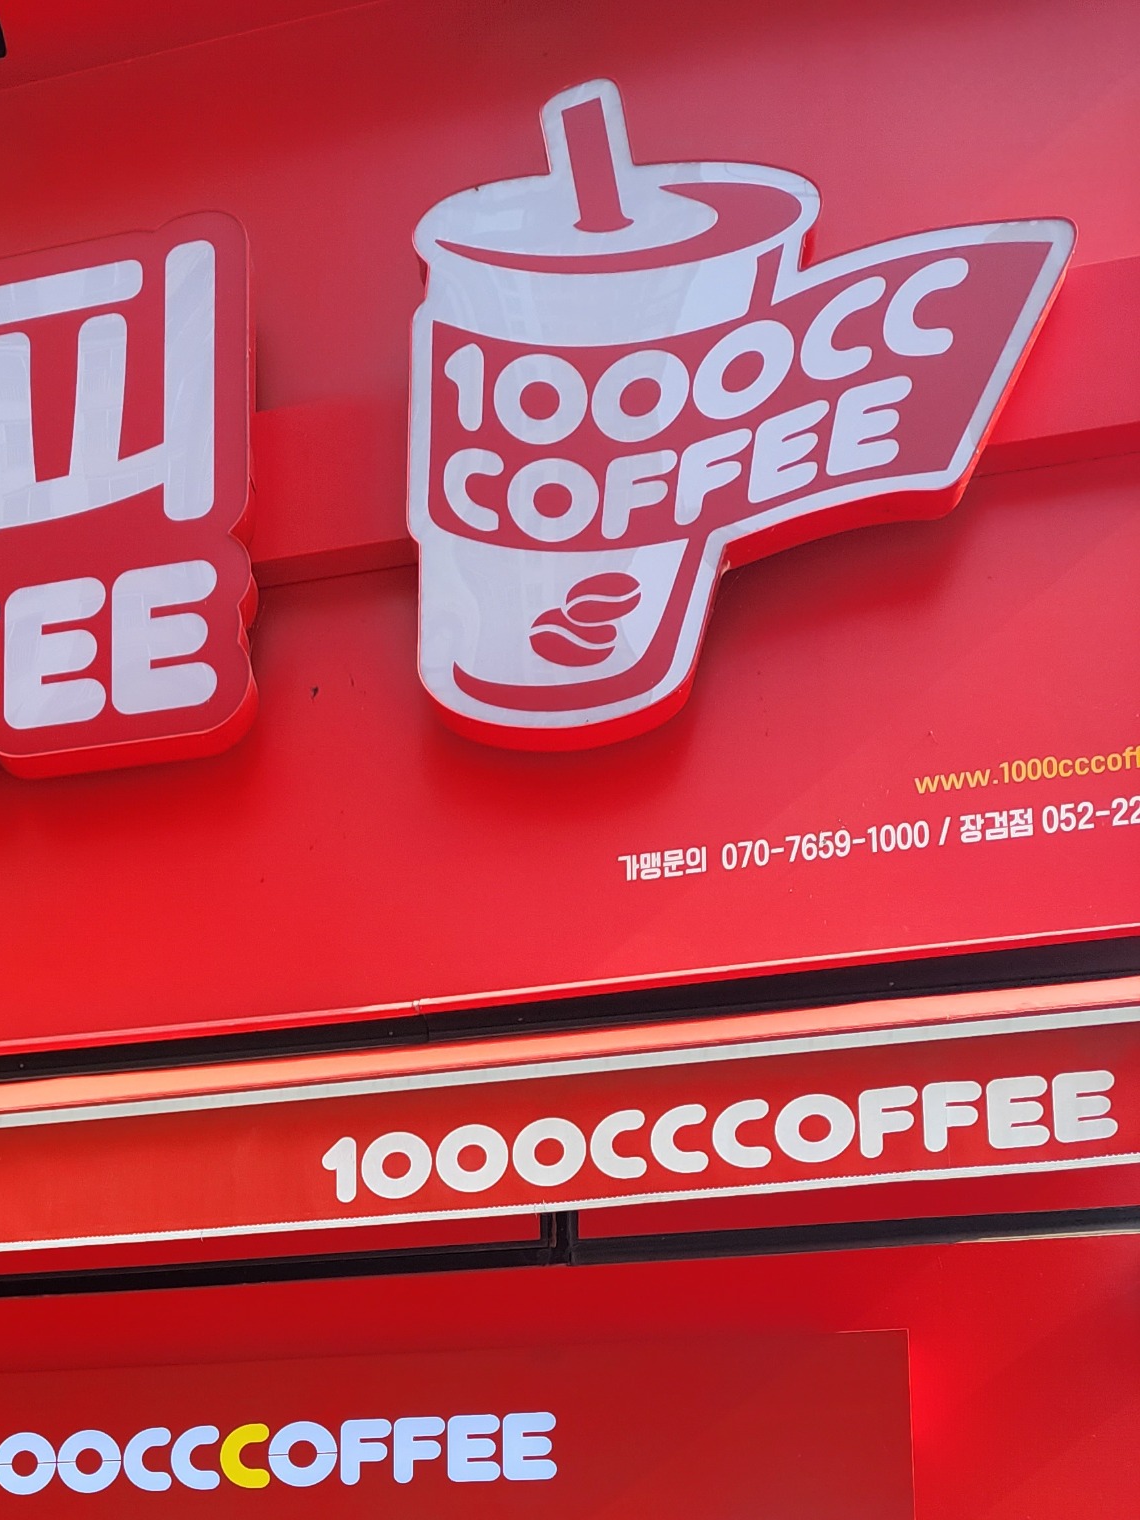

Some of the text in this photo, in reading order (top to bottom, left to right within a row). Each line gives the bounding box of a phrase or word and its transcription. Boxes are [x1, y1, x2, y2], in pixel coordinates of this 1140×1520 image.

[443, 257, 970, 445] 1000CC
[443, 375, 913, 542] COFFEE
[618, 847, 707, 882] 가맹문의
[721, 820, 930, 871] 070-7659-1000
[959, 807, 1034, 844] 장검점
[321, 1069, 1119, 1204] 1000CCCOFFEE
